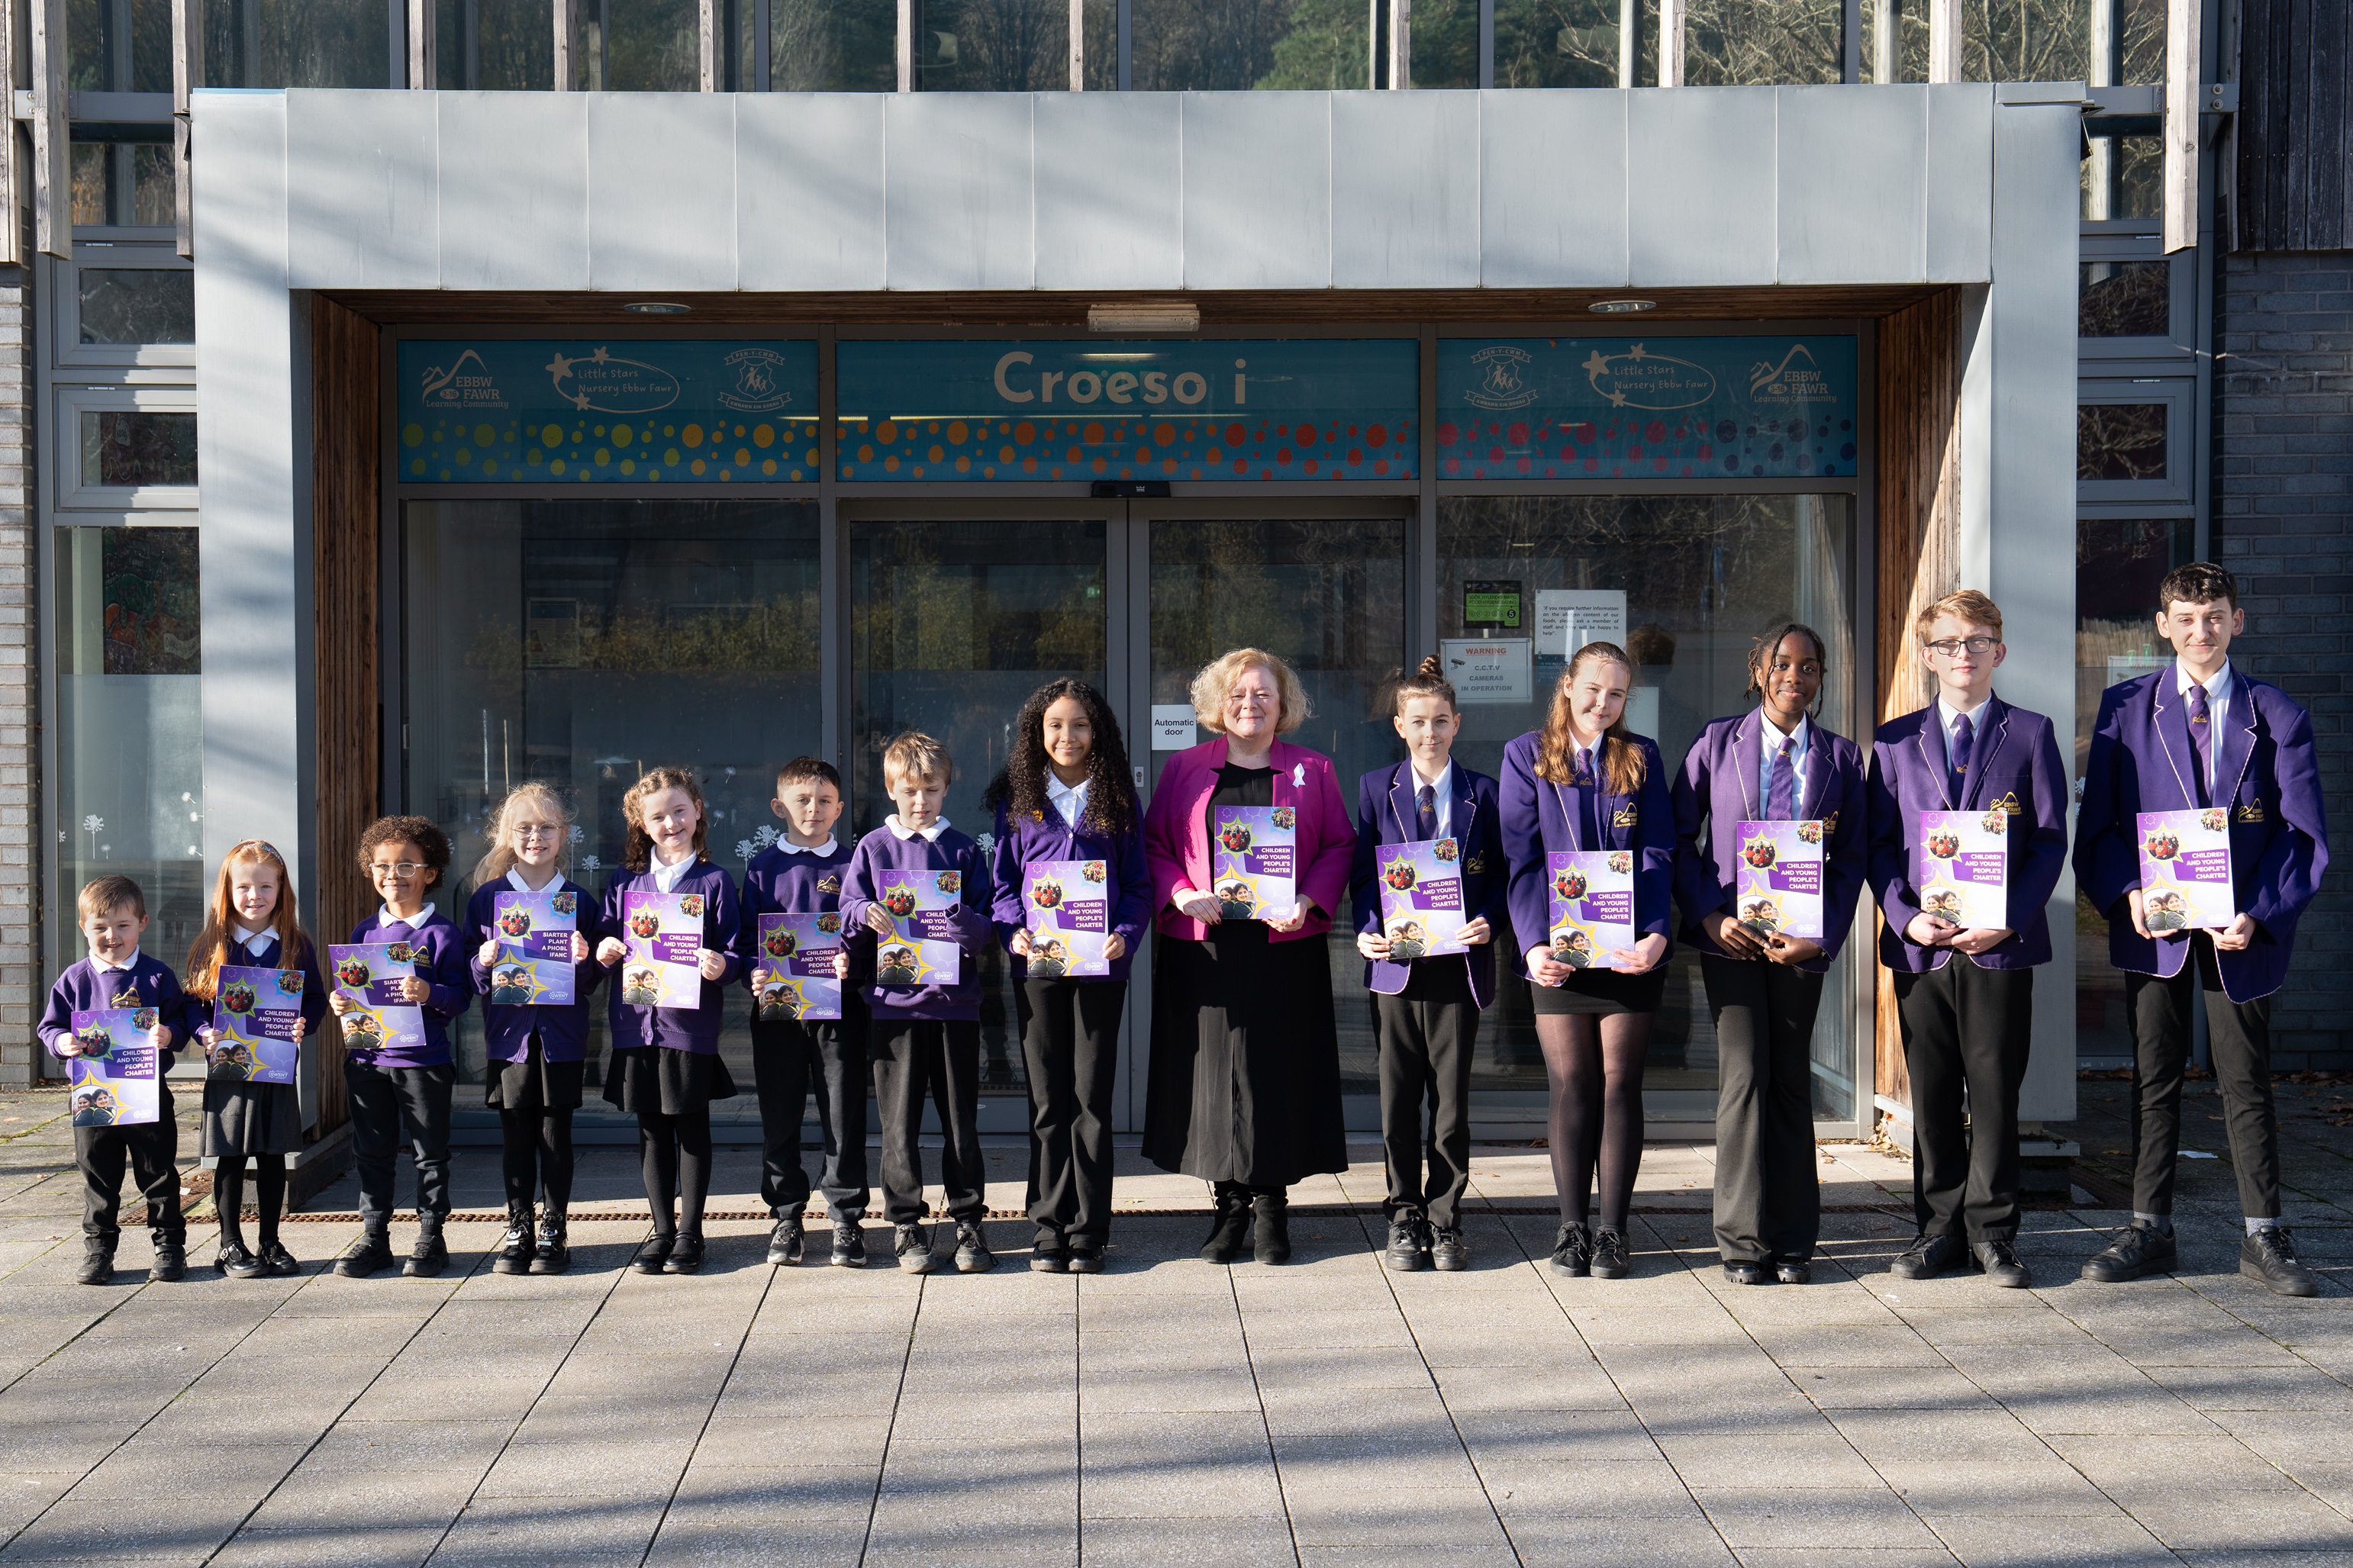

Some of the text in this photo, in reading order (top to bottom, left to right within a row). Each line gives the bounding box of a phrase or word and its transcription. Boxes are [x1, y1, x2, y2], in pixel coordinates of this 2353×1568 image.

[579, 368, 638, 378] Little Stars
[1615, 365, 1674, 375] Little Stars
[994, 351, 1246, 404] Croeso i
[1784, 371, 1822, 382] EBBW
[456, 377, 493, 388] EBBW
[1615, 380, 1708, 393] Nursery Ebbw Fawr
[579, 383, 672, 396] Nursery Ebbw Fawr
[1791, 383, 1828, 394] FAWR
[463, 389, 500, 400] FAWR
[1791, 394, 1837, 403] Community
[426, 401, 509, 409] Learning Community
